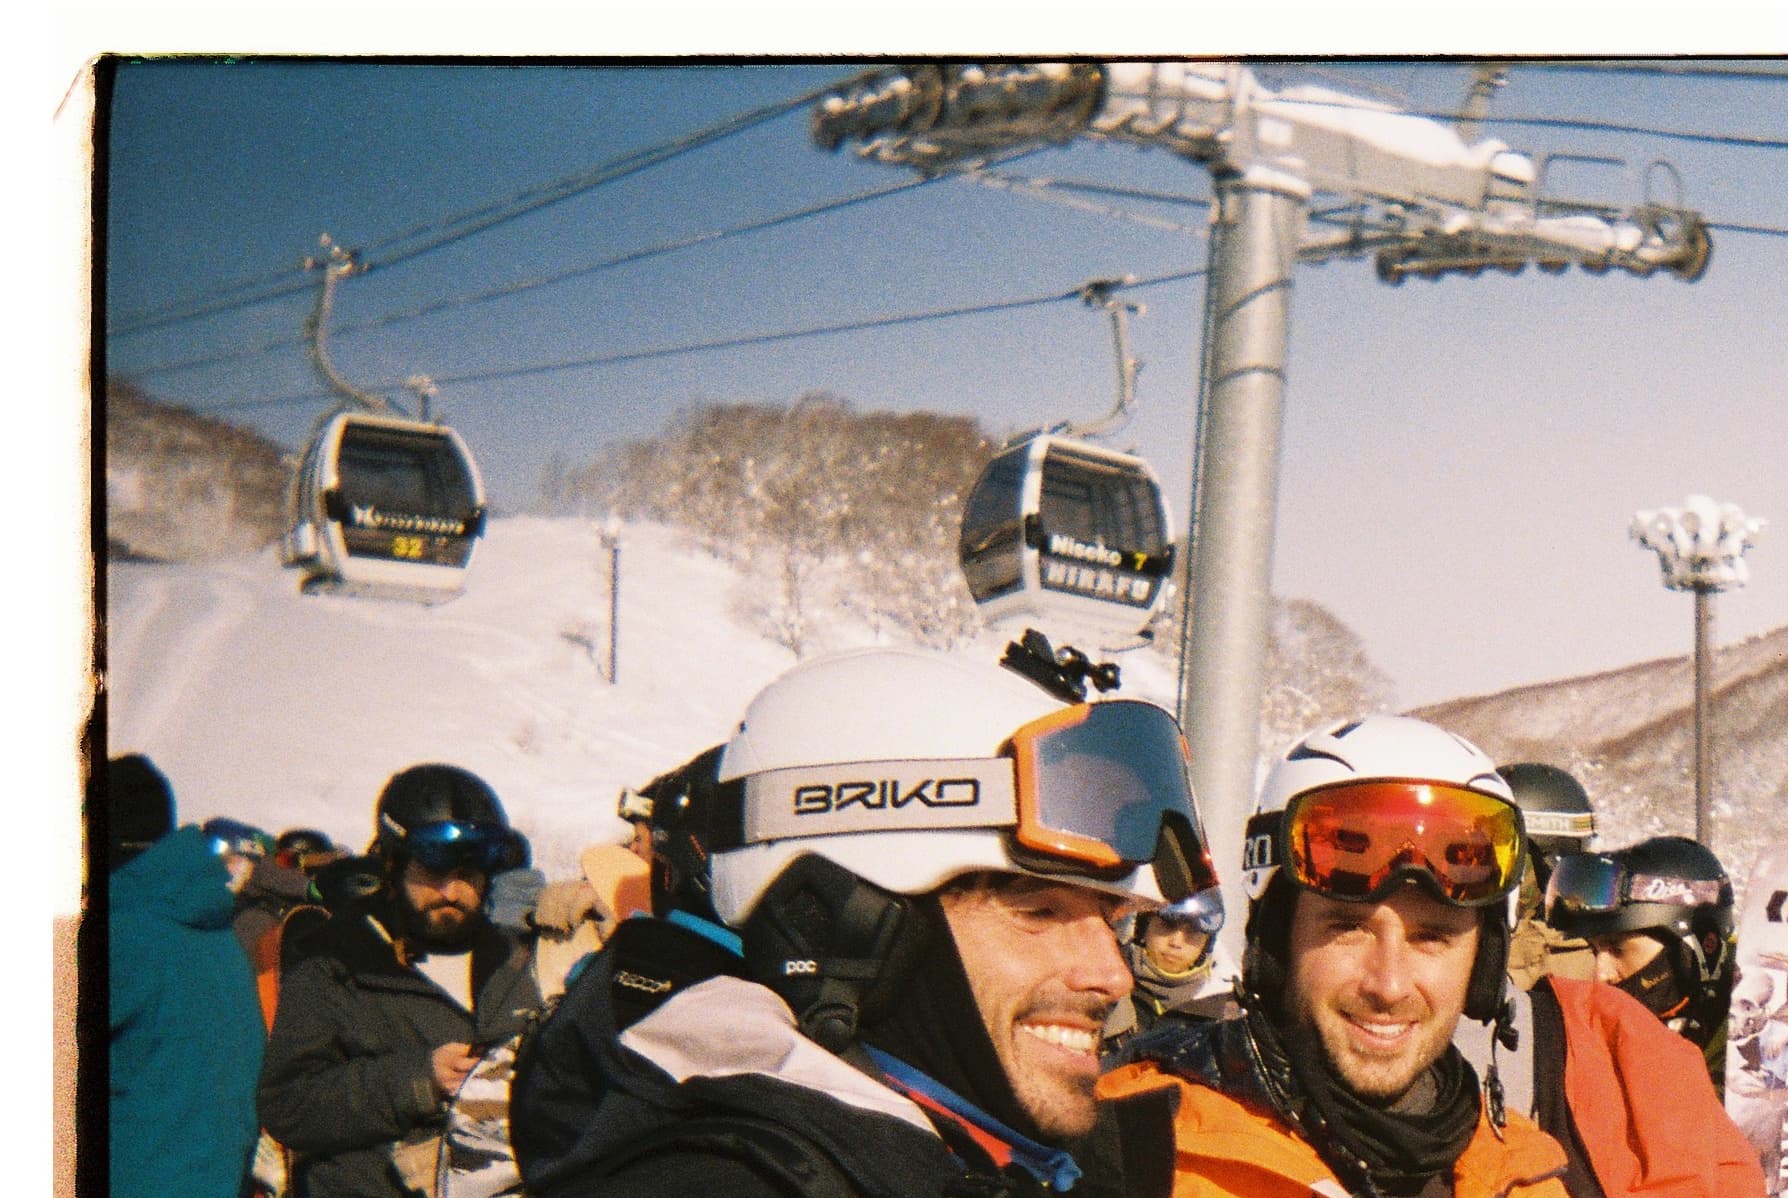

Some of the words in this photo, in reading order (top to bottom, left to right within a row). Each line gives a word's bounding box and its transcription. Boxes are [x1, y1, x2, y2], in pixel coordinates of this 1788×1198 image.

[1050, 533, 1122, 567] Niseko
[1134, 551, 1148, 571] 7
[1046, 562, 1151, 601] HIRAFU
[793, 778, 982, 815] BRIKO
